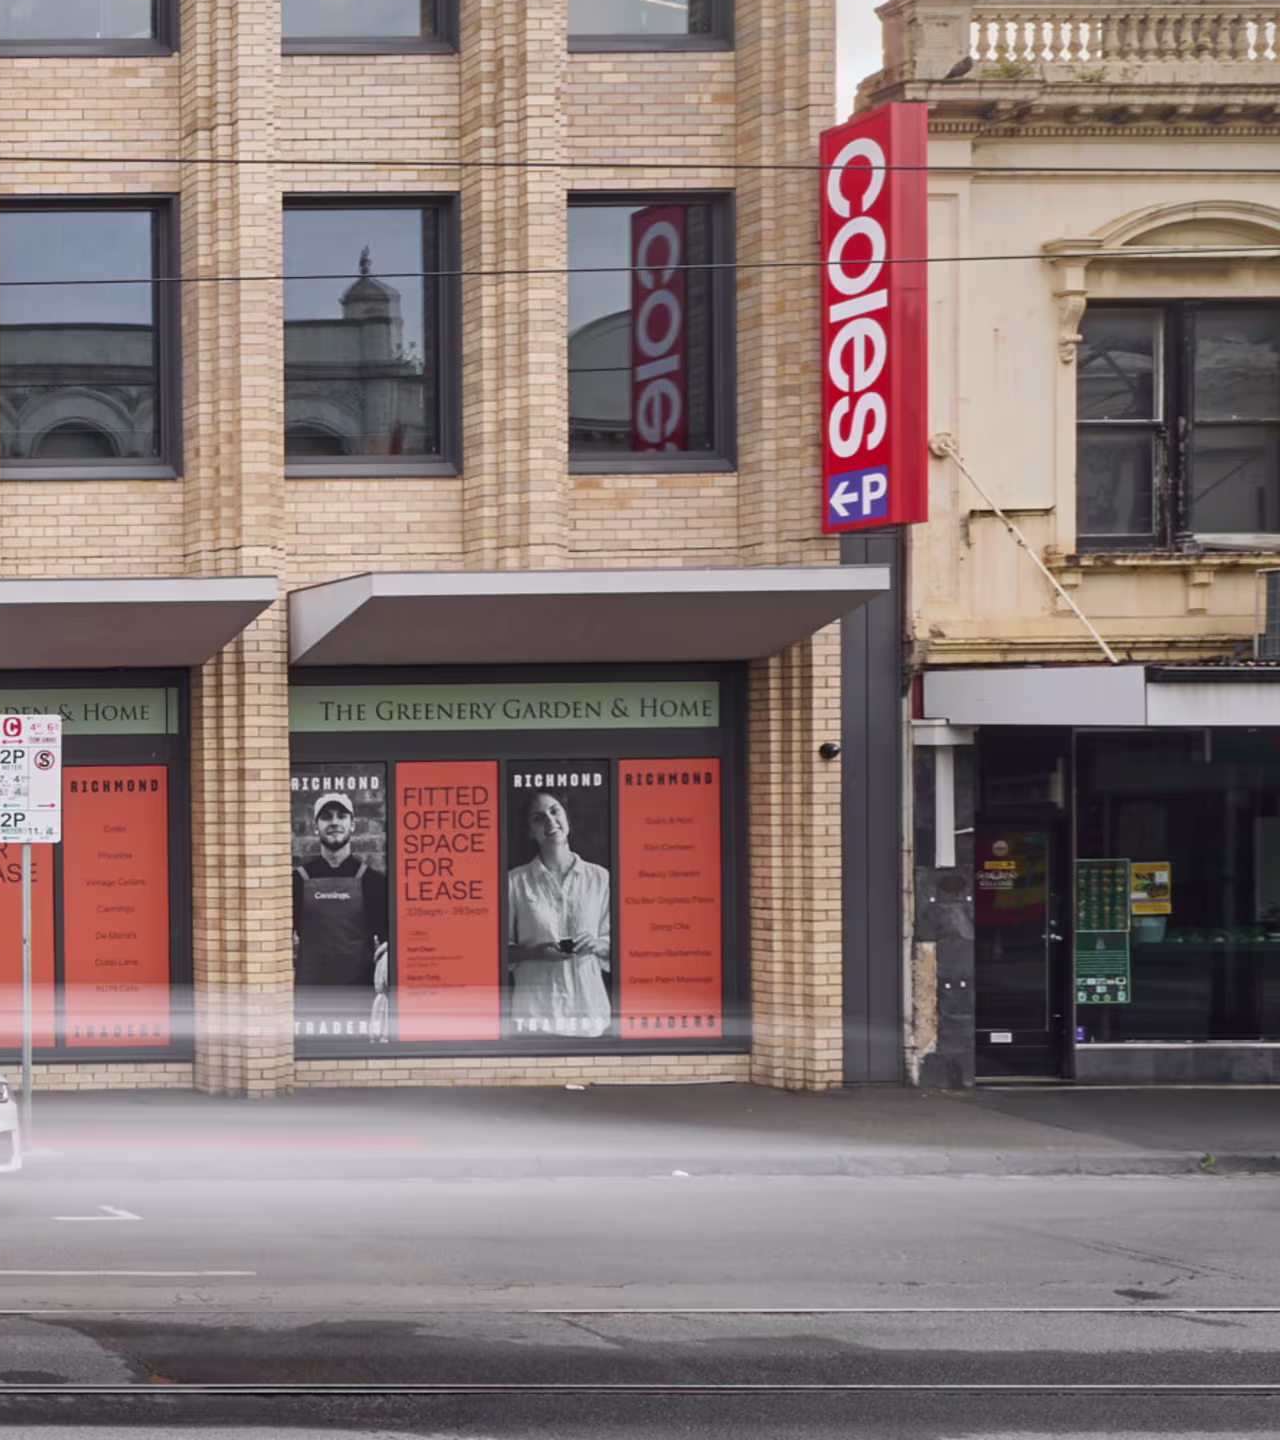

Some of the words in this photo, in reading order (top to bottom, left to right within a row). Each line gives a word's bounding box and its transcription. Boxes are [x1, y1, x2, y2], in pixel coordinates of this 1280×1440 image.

[827, 137, 888, 458] coles
[862, 471, 888, 516] P
[83, 703, 150, 721] HOME
[319, 701, 367, 721] THE
[375, 700, 496, 722] GREENERY
[502, 698, 602, 720] GARDEN
[611, 698, 630, 718] &
[640, 697, 712, 718] HOME
[0, 749, 25, 764] 2P
[70, 778, 158, 793] RICHMOND
[291, 776, 379, 790] RICHMOND
[514, 772, 602, 788] RICHMOND
[625, 771, 712, 786] RICHMOND
[404, 786, 488, 806] FITTED
[0, 812, 26, 827] 2P
[403, 809, 490, 830] OFFICE
[403, 833, 485, 854] SPACE
[405, 857, 454, 877] FOR
[405, 880, 483, 901] LEASE
[74, 1024, 161, 1038] TRADERS
[628, 1015, 715, 1030] TRADERS
